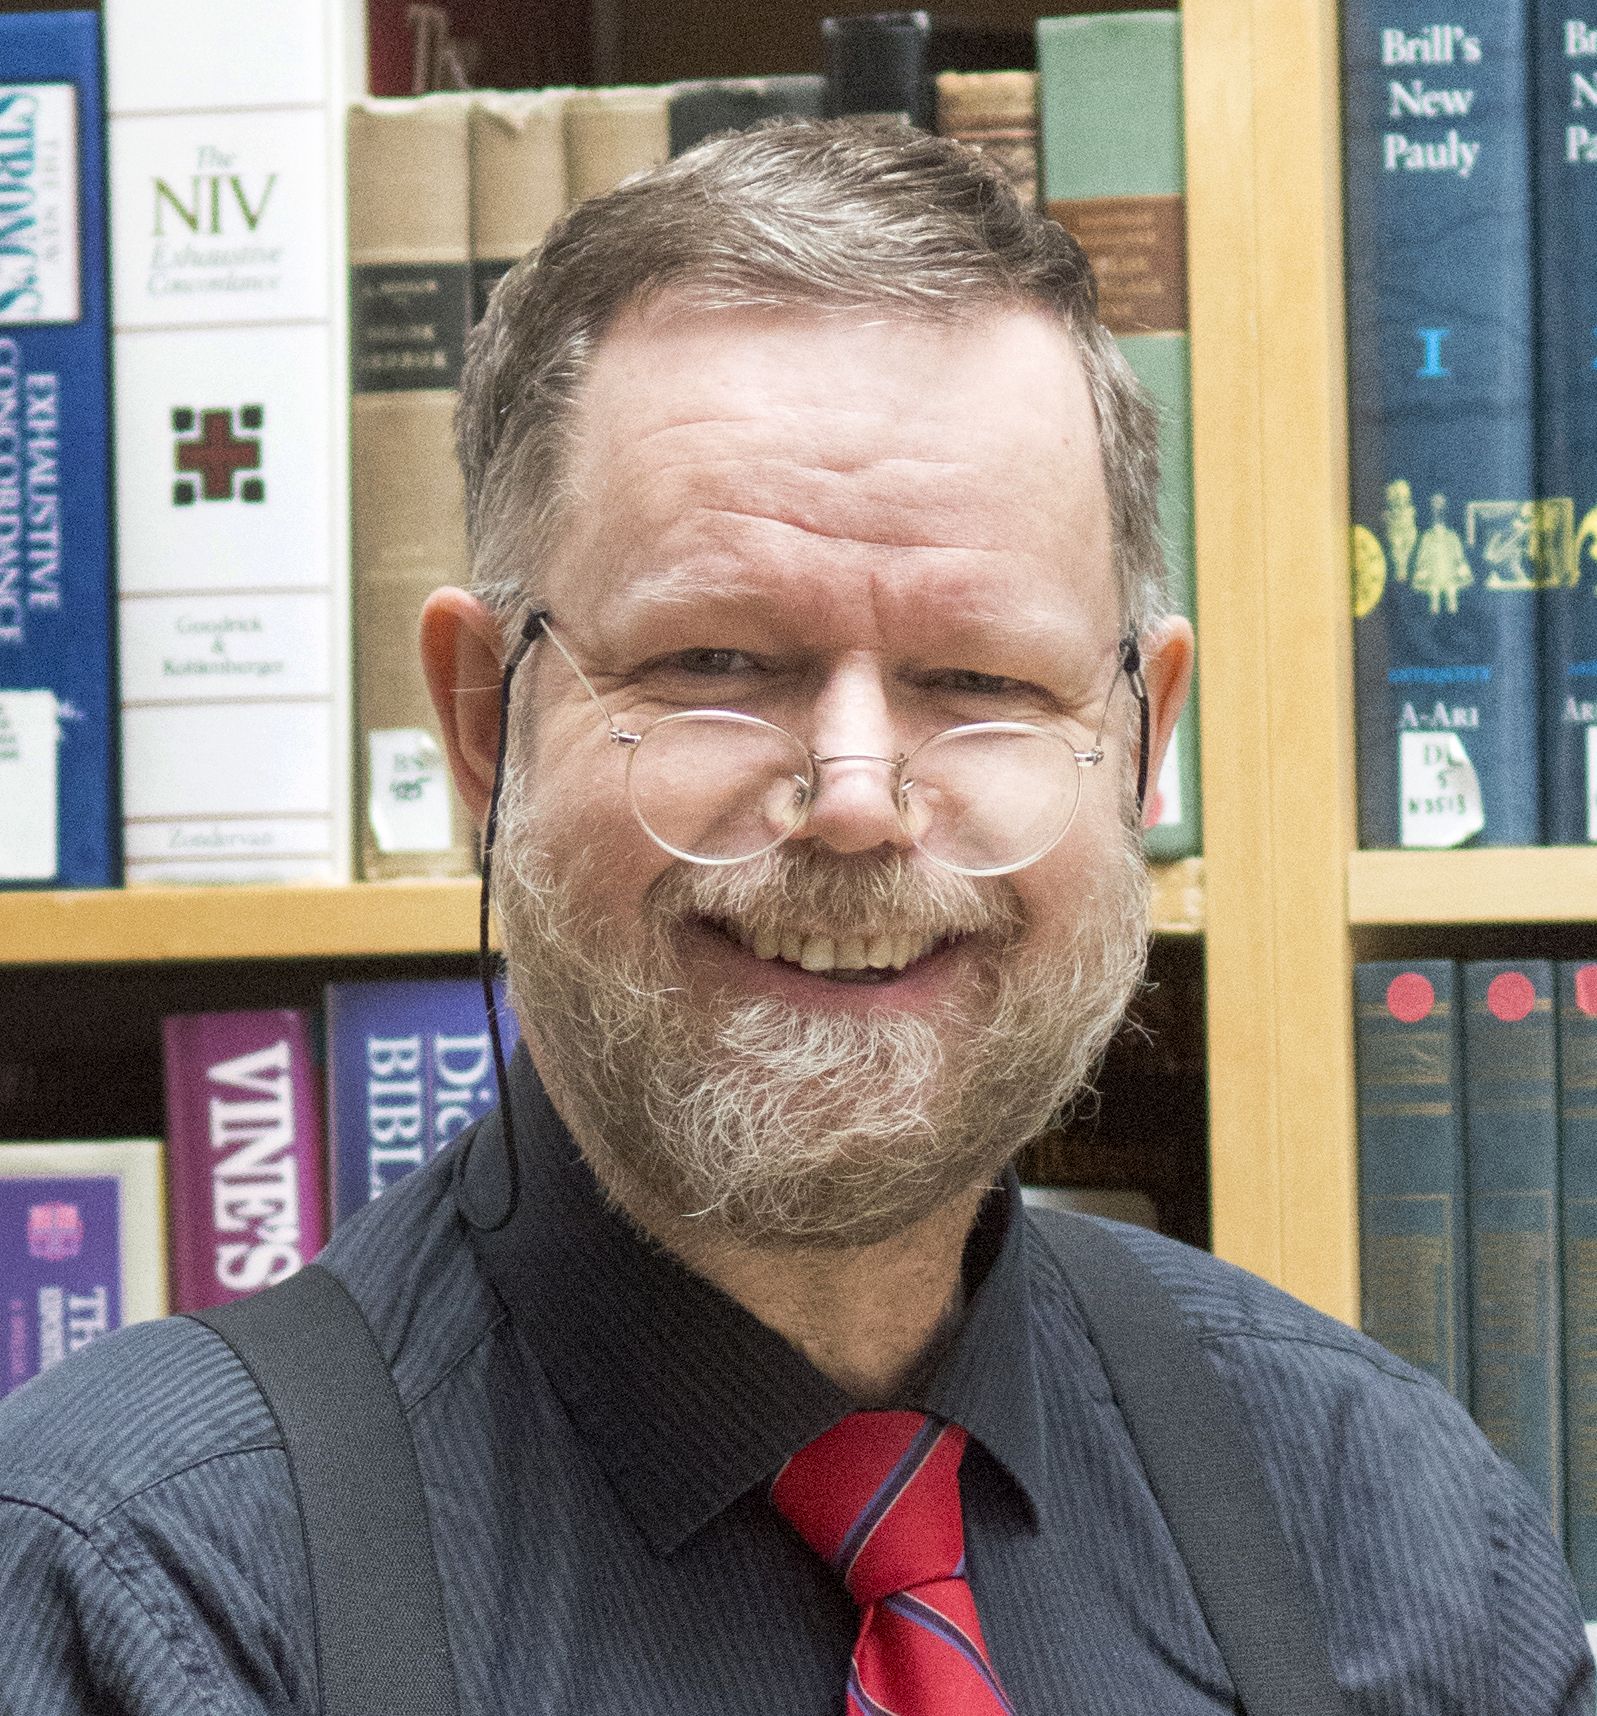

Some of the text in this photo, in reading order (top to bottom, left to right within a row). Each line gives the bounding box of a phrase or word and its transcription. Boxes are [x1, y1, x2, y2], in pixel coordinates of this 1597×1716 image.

[1382, 24, 1482, 65] Brill's
[1388, 79, 1474, 118] New
[196, 144, 237, 169] The
[1383, 128, 1480, 178] Pauly
[149, 172, 280, 237] NIV
[26, 372, 62, 611] EXHAUSTIVE
[434, 1033, 493, 1152] Dic
[206, 1041, 304, 1292] VINE'S
